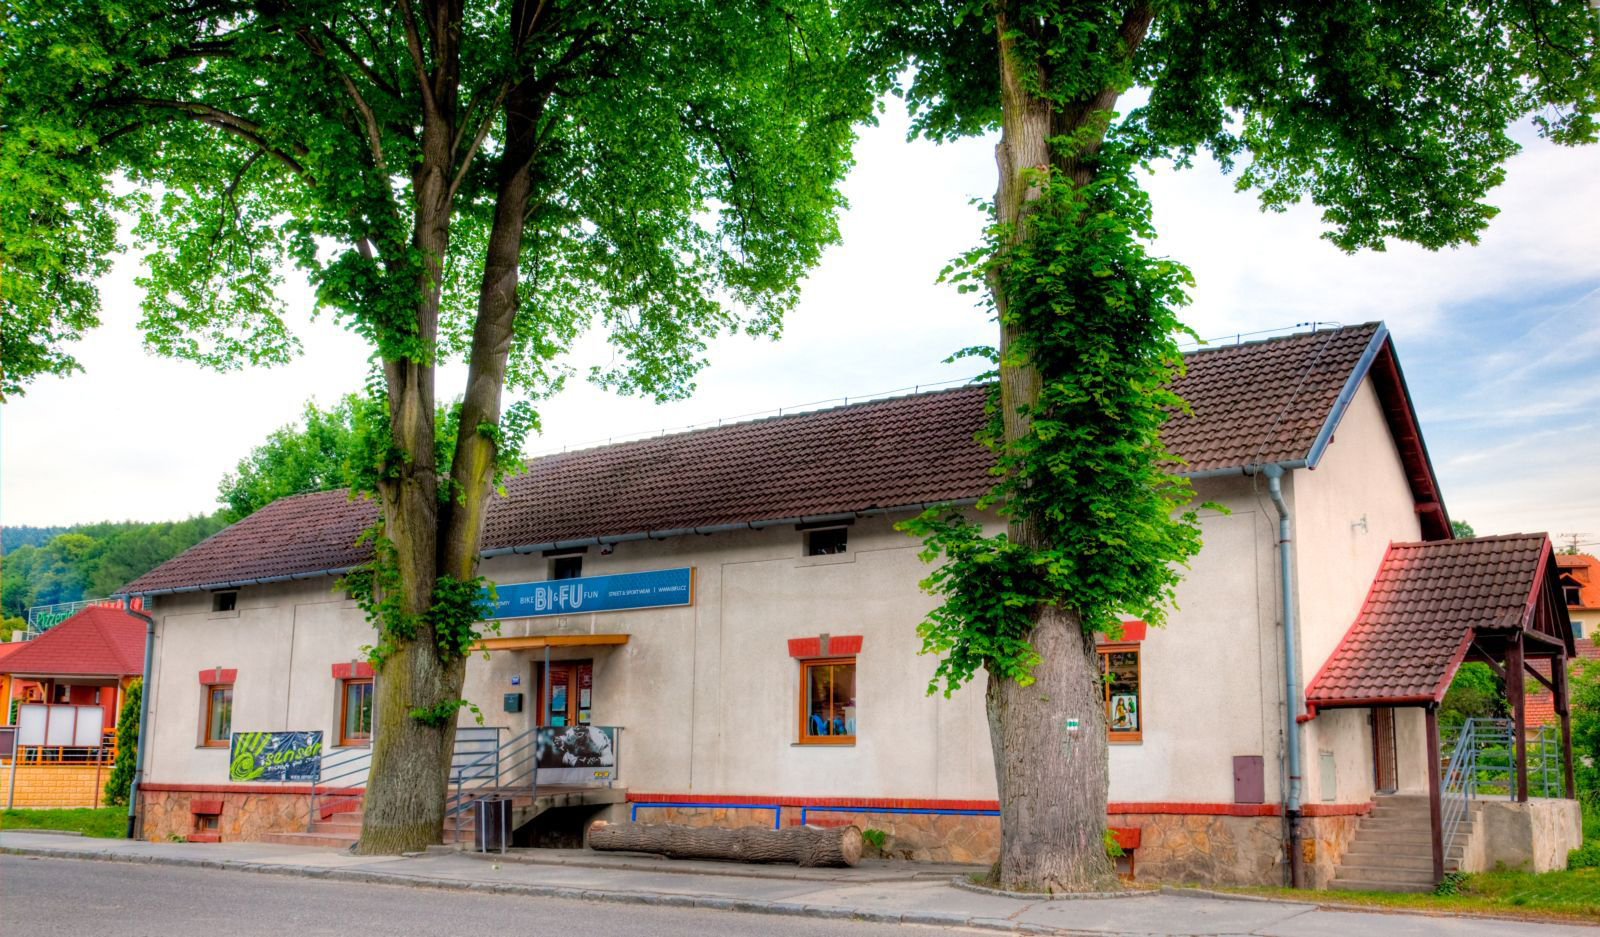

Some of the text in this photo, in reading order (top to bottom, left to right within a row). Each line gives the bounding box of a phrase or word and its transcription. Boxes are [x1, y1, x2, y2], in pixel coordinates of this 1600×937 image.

[520, 596, 534, 604] BIKE
[535, 585, 553, 610] BI
[553, 592, 559, 602] &
[559, 583, 583, 610] FU
[583, 591, 599, 599] FUN
